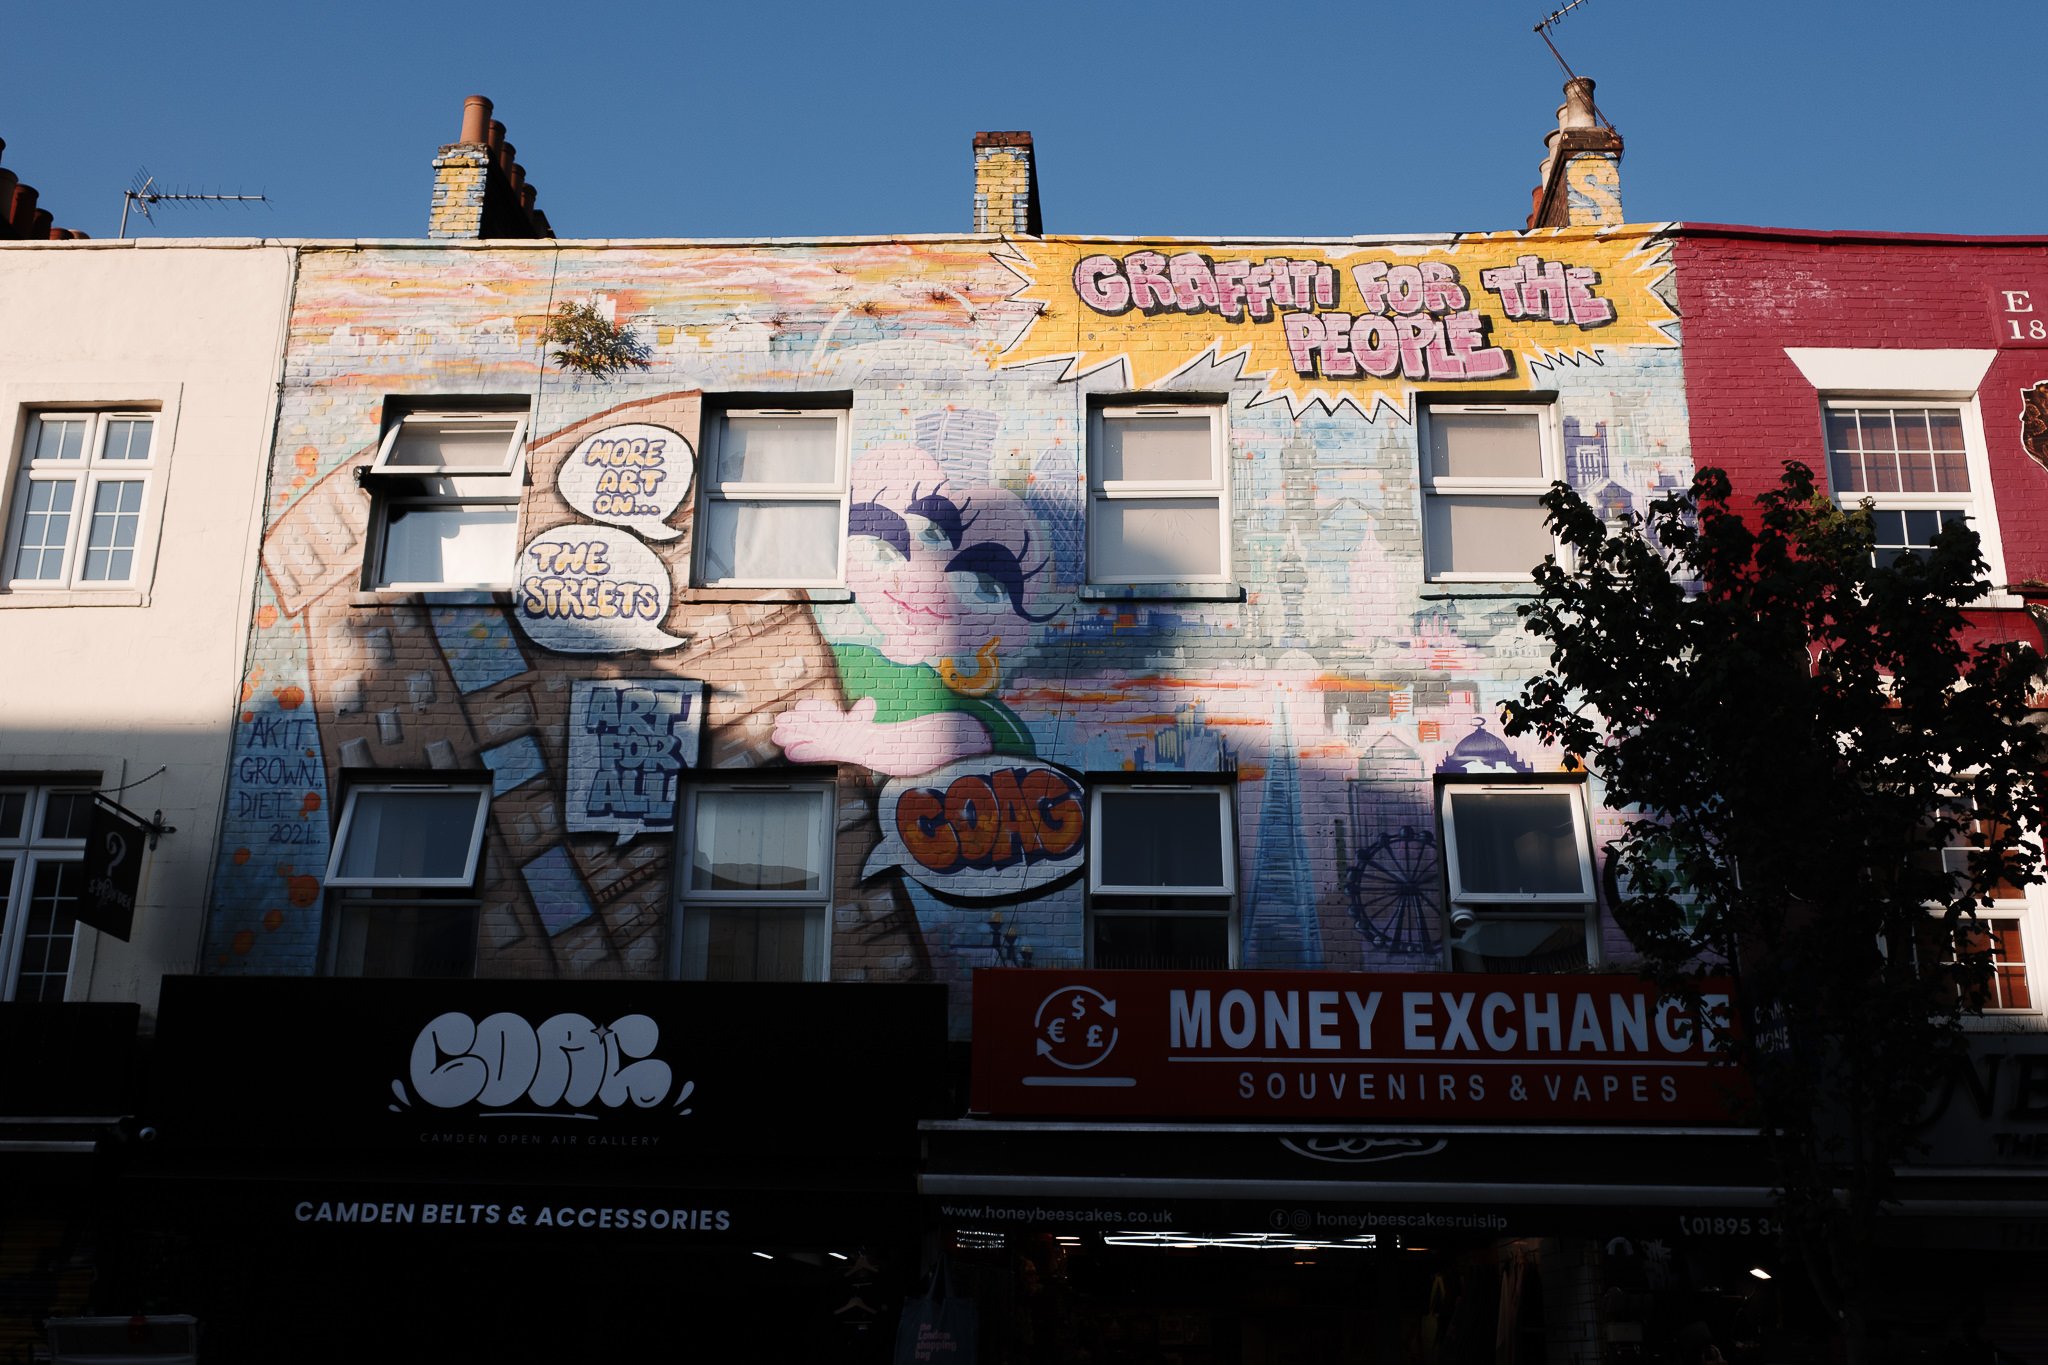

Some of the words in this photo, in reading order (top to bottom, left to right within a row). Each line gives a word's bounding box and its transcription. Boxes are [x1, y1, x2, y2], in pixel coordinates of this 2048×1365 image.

[1073, 251, 1341, 322] GRAFFITI
[1351, 260, 1471, 315] FOR
[1480, 253, 1617, 330] THE
[1283, 311, 1517, 380] PEOPLE
[585, 438, 667, 467] MORE
[596, 469, 667, 496] ART
[528, 541, 611, 575] THE
[522, 576, 661, 621] STREETS
[585, 687, 694, 736] ART
[589, 733, 687, 772] FOR
[587, 768, 678, 827] ALL
[896, 767, 1085, 875] COAG
[1169, 988, 1383, 1050] MONEY
[1402, 991, 1730, 1054] EXCHANGE
[1238, 1071, 1486, 1101] SOUVENIRS
[1508, 1074, 1528, 1102] &
[1544, 1075, 1678, 1103] VAPES
[419, 1132, 488, 1145] CAMDEN
[499, 1134, 541, 1146] OPEN
[551, 1135, 578, 1146] AIR
[587, 1135, 661, 1147] GALLERY
[295, 1201, 416, 1224] CAMDEN
[421, 1203, 501, 1225] BELTS
[506, 1205, 528, 1227] &
[535, 1207, 732, 1231] ACCESSORIES
[941, 1205, 1174, 1225] www.honeybeescakes.co.uk
[1316, 1210, 1509, 1232] honeybeescakesruislip
[1692, 1216, 1753, 1237] 01895
